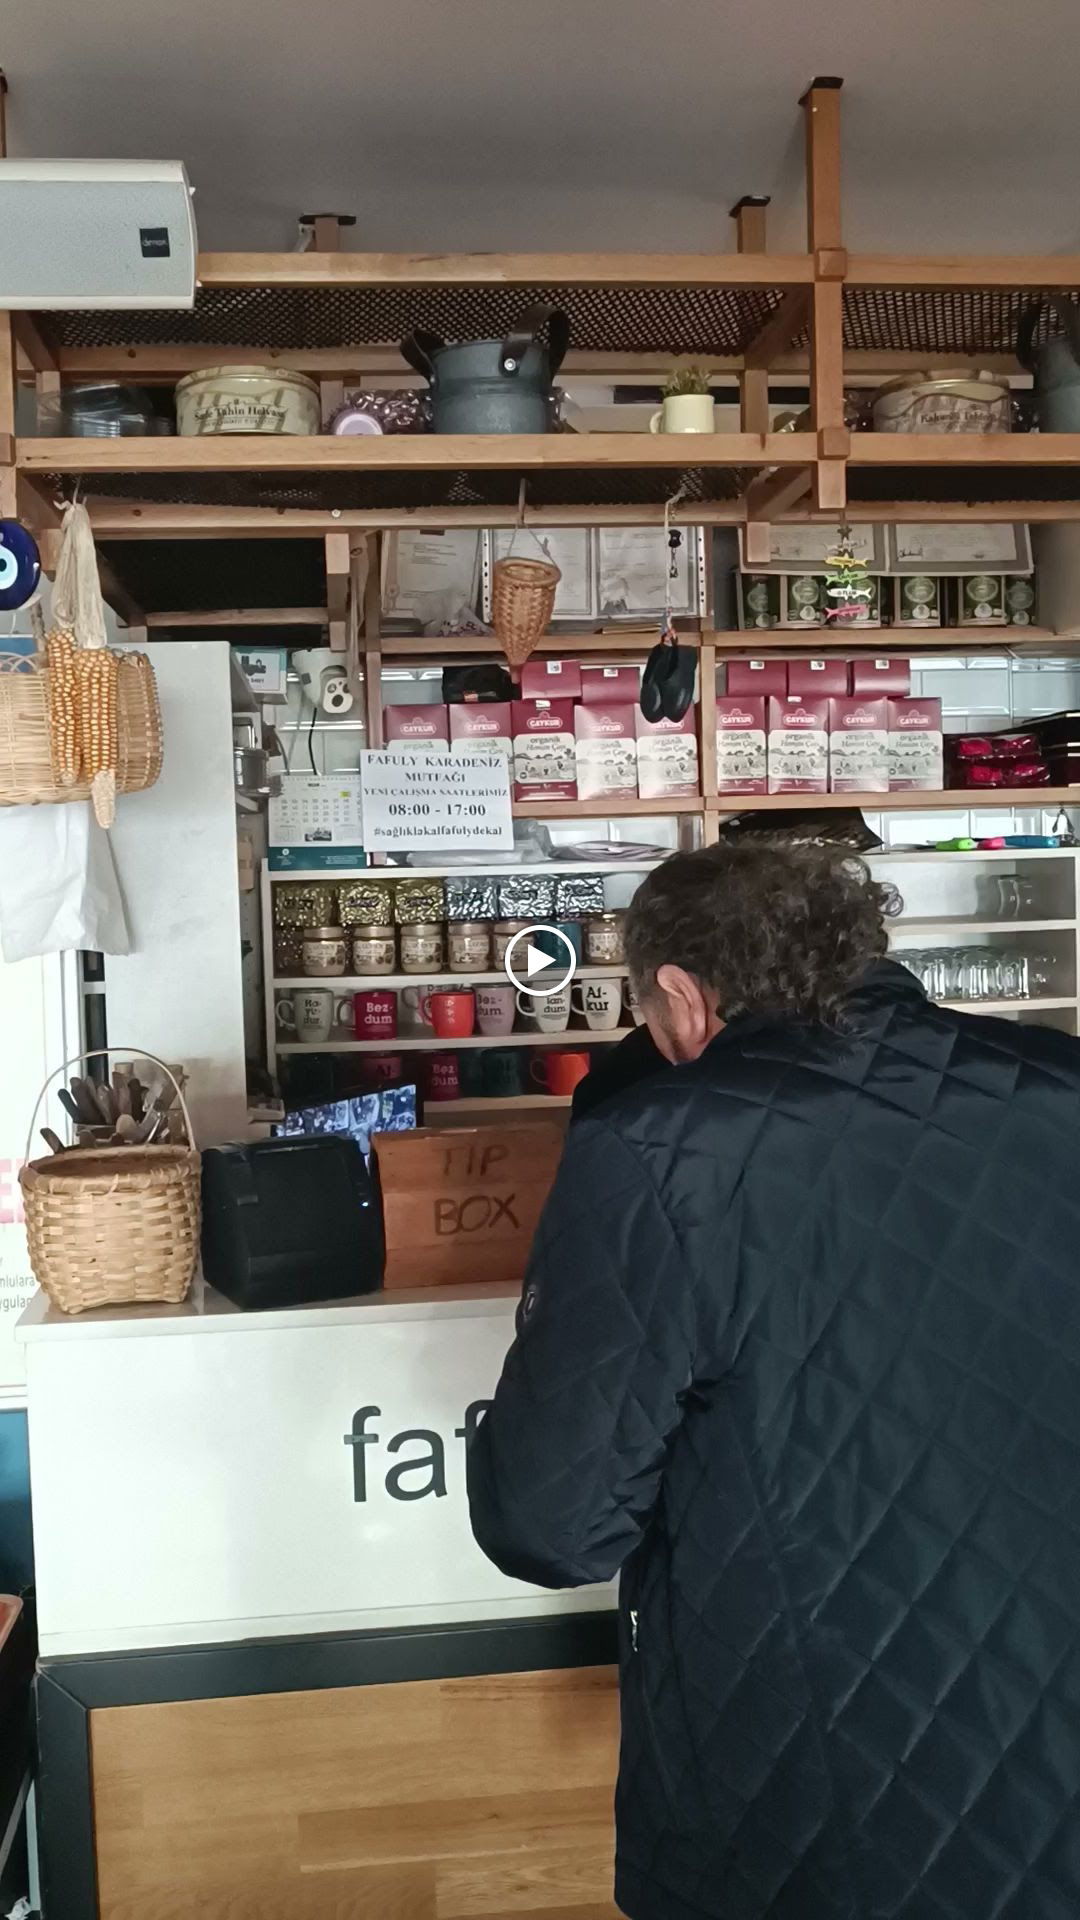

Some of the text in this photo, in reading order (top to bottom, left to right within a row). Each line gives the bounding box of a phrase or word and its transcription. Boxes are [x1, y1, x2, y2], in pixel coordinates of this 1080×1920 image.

[368, 754, 502, 768] FAFULY KARADENİZ
[405, 771, 465, 782] MUTFAĞI
[364, 787, 388, 796] YENİ
[440, 788, 507, 797] SAATLERİMİZ
[388, 803, 430, 816] 08:00
[447, 804, 486, 816] 17:00
[366, 1002, 393, 1013] Bez-
[586, 998, 609, 1011] kur
[364, 1013, 393, 1024] dum
[431, 1144, 510, 1177] TIP
[433, 1193, 521, 1236] BOX
